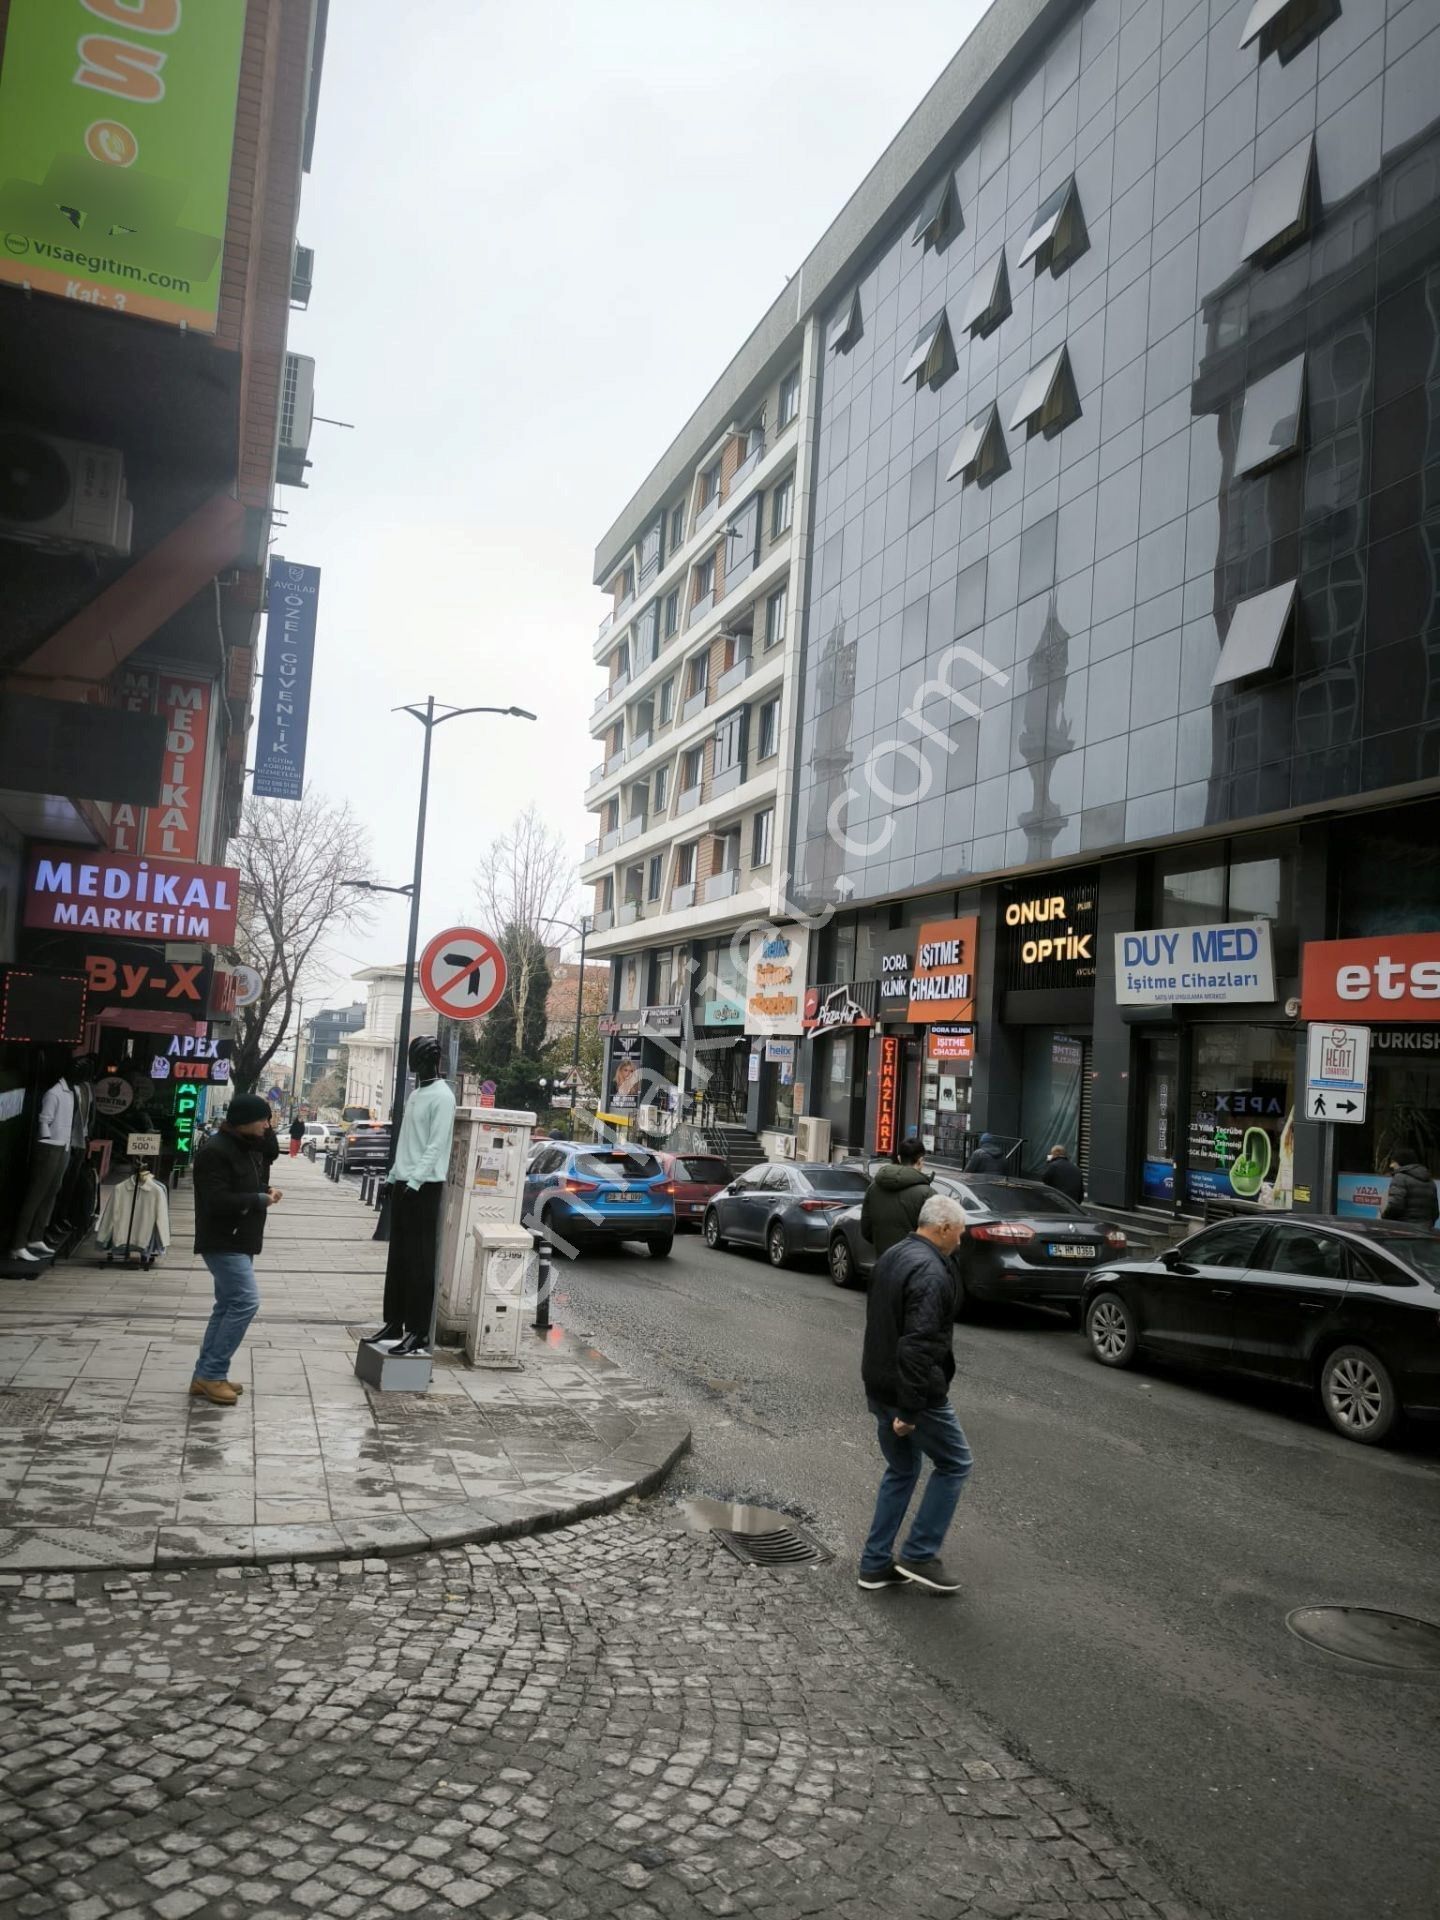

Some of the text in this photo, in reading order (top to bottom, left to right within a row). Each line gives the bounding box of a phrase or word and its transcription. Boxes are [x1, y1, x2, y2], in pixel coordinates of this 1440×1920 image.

[113, 293, 127, 312] 3
[284, 593, 304, 644] ÖZEL
[159, 684, 202, 852] MEDİKAL
[35, 859, 231, 911] MEDİKAL
[53, 902, 209, 937] MARKETİM
[1005, 896, 1066, 926] ONUR
[919, 939, 960, 971] İŞİTME
[1022, 927, 1093, 964] OPTİK
[1124, 928, 1258, 967] DUY MED
[85, 955, 205, 1000] By-X
[882, 953, 908, 972] DORA
[1336, 956, 1440, 1000] ets
[881, 974, 907, 997] KLİNİK
[909, 973, 968, 1001] CİHAZLARI
[1127, 972, 1258, 993] İşitme Cihazları
[168, 1034, 219, 1059] APEX
[769, 1044, 792, 1055] helix
[131, 1142, 150, 1150] 500
